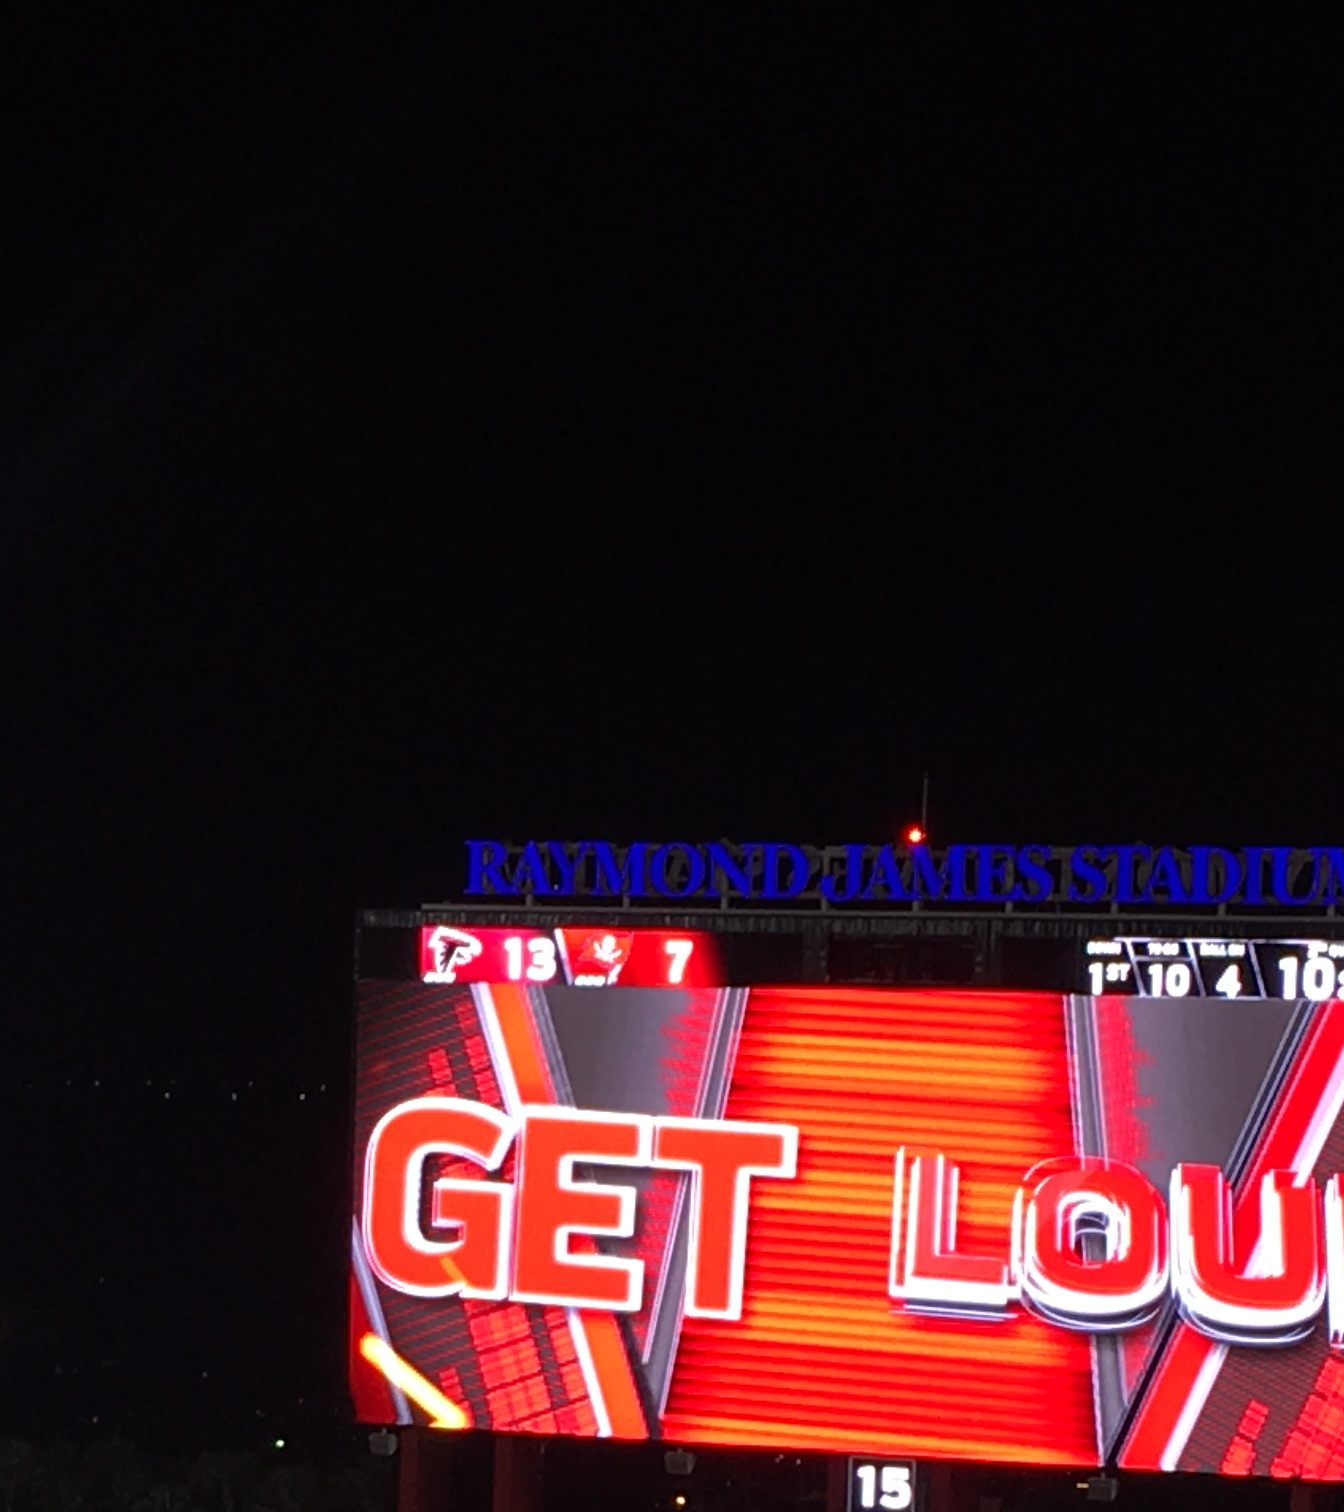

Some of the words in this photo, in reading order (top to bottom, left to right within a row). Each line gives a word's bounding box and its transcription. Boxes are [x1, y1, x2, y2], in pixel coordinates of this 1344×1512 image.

[463, 839, 811, 900] RAYMOND
[821, 842, 1055, 902] JAMES
[502, 936, 557, 981] 13
[663, 940, 695, 983] 7
[1088, 962, 1131, 996] 1ST
[1148, 963, 1191, 998] 10
[1215, 963, 1242, 999] 4
[363, 1095, 800, 1322] GET
[856, 1464, 913, 1512] 15
